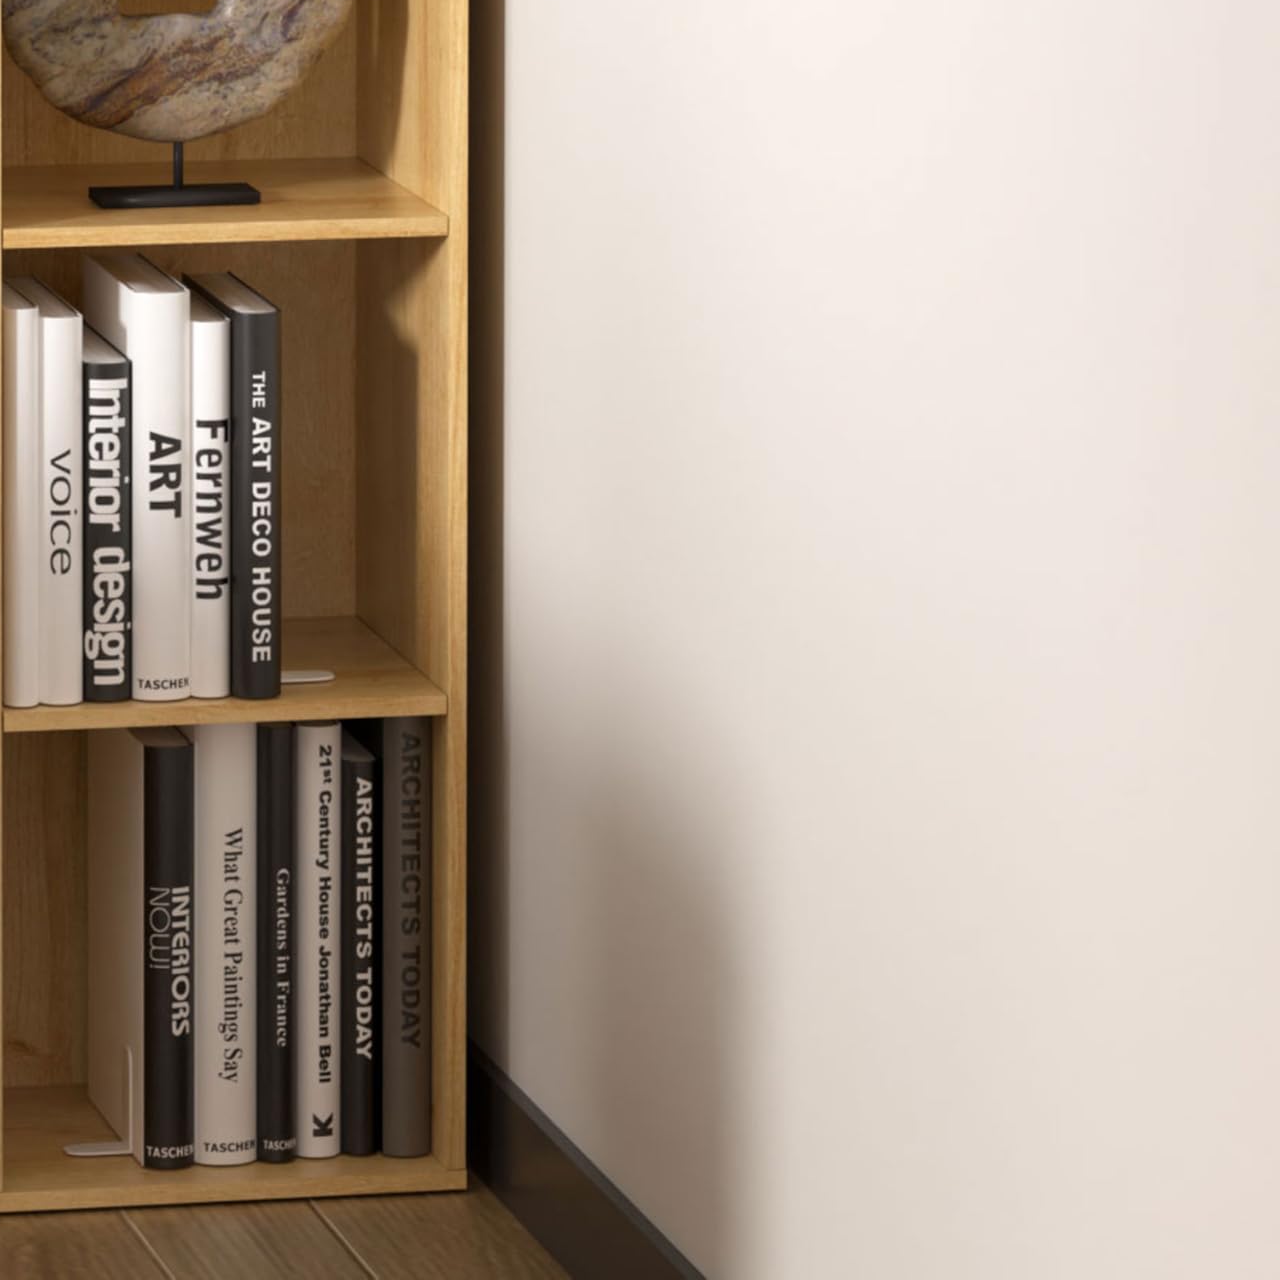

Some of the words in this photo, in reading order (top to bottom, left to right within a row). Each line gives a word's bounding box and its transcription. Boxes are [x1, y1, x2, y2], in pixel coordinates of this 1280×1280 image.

[251, 370, 267, 409] THE
[88, 377, 130, 533] Interior
[148, 430, 183, 519] ART
[251, 416, 272, 473] ART
[49, 448, 79, 576] voice
[195, 418, 233, 601] Fernweh
[251, 481, 272, 558] DECO
[84, 545, 131, 687] design
[251, 566, 272, 664] HOUSE
[319, 744, 333, 785] 21st
[223, 827, 244, 883] What
[315, 790, 332, 870] Century
[356, 775, 373, 960] ARCHITECTS
[402, 732, 421, 936] ARCHITECTS
[149, 886, 171, 970] NOW!
[223, 888, 244, 944] Great
[275, 867, 291, 951] Gardens
[319, 876, 332, 940] House
[171, 885, 190, 1037] INTERIORS
[217, 951, 244, 1043] Paintings
[275, 955, 291, 975] in
[318, 945, 332, 1038] Jonathan
[402, 945, 421, 1049] TODAY
[275, 981, 291, 1048] France
[356, 967, 373, 1060] TODAY
[217, 1047, 244, 1084] Say
[318, 1045, 332, 1084] Bell
